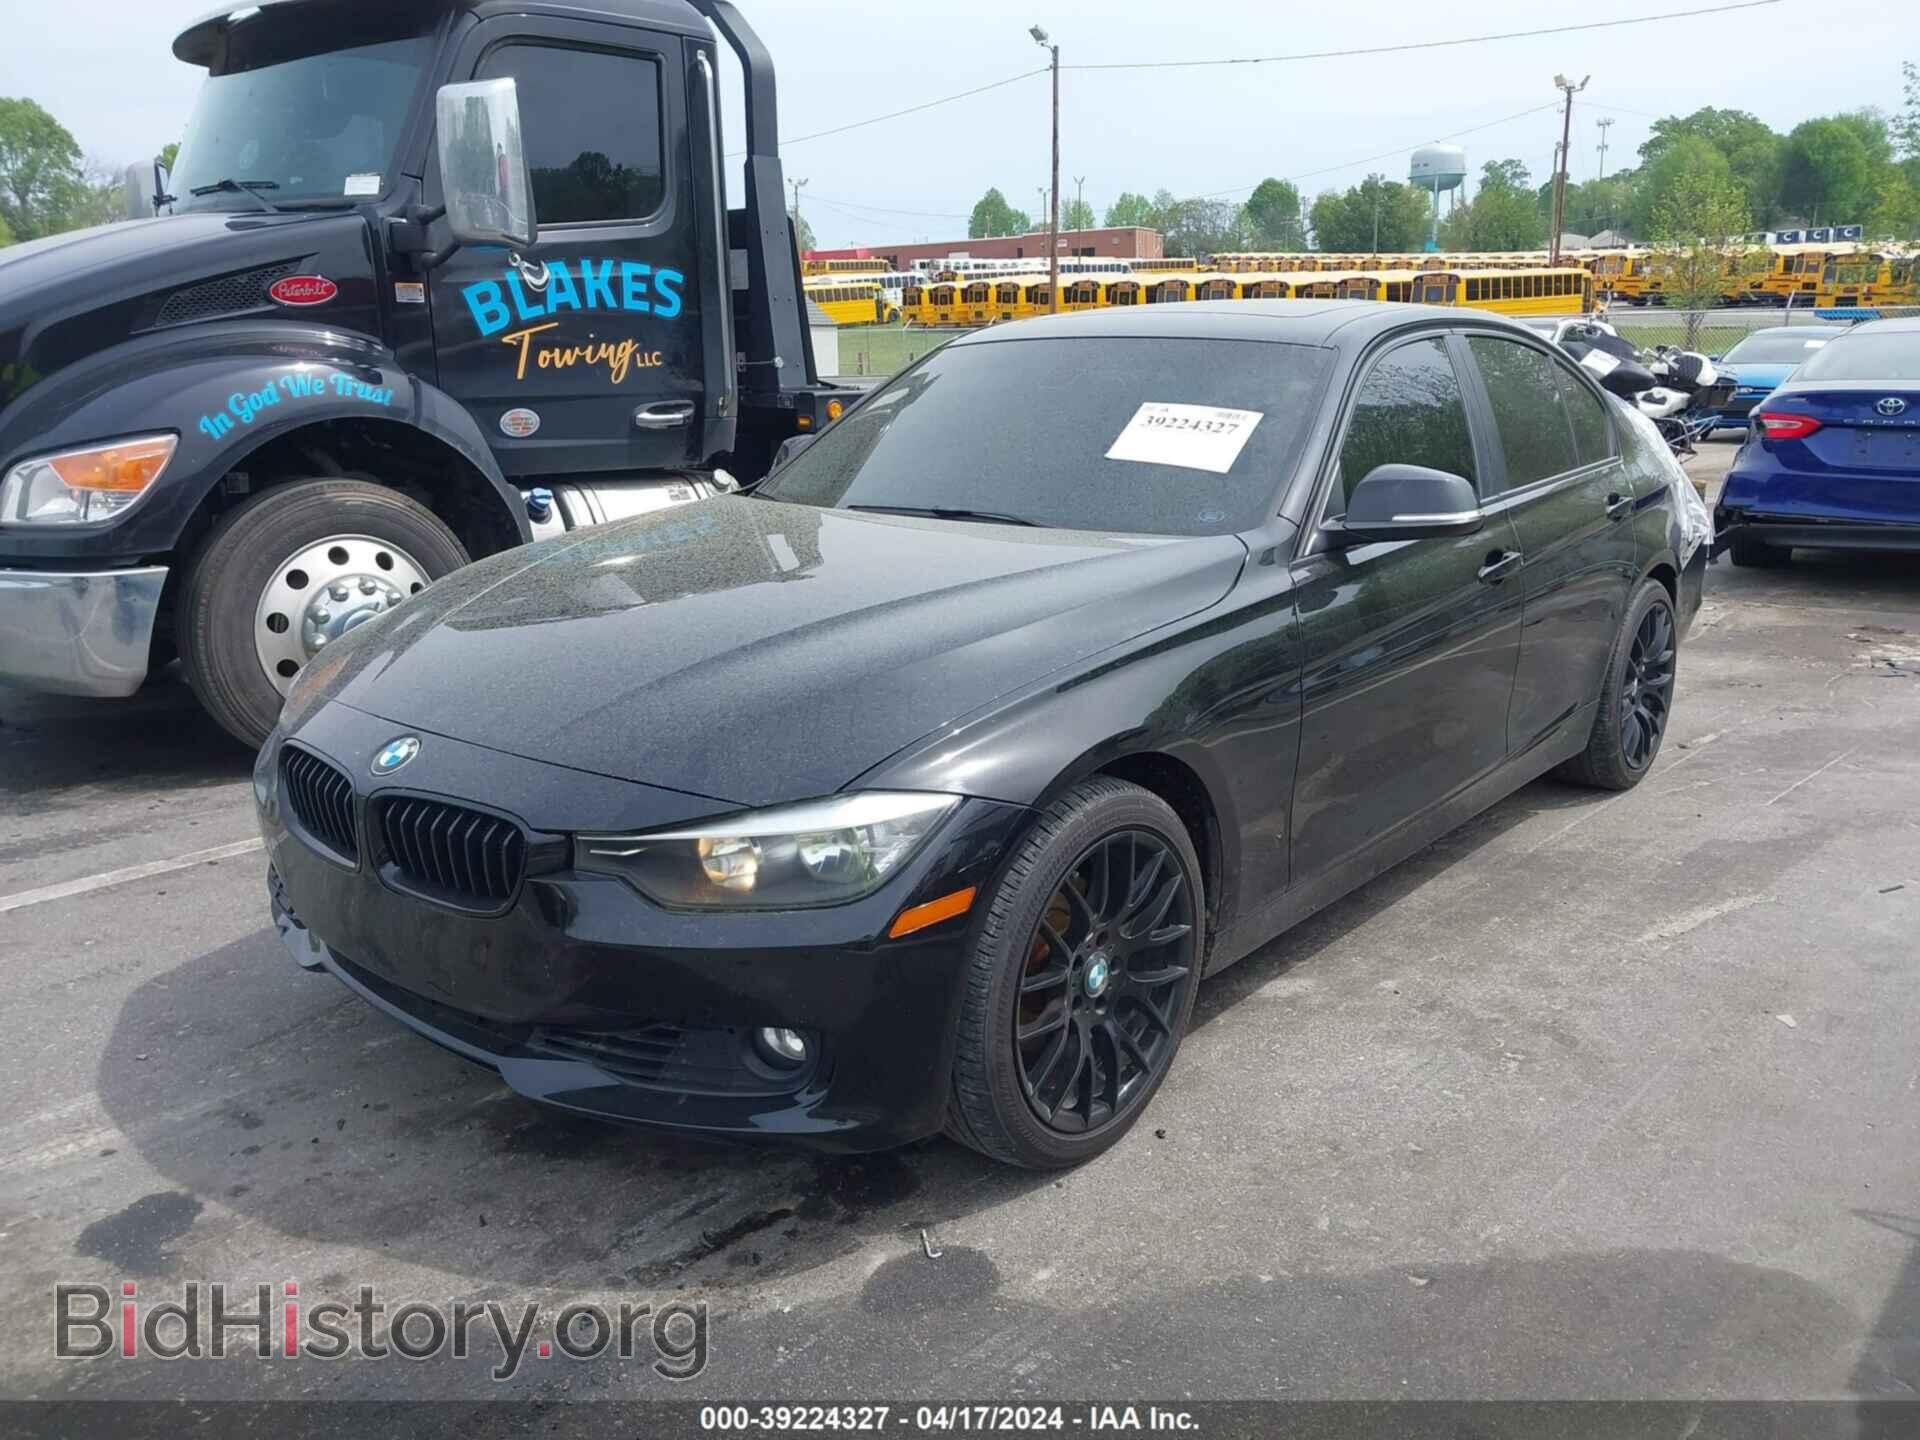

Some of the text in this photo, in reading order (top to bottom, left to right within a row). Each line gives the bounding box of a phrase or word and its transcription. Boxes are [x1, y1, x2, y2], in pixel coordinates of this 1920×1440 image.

[462, 259, 684, 336] BLAKES
[501, 321, 664, 384] Towing LLC
[199, 371, 395, 440] In God We Trust
[1140, 415, 1240, 435] 39224327
